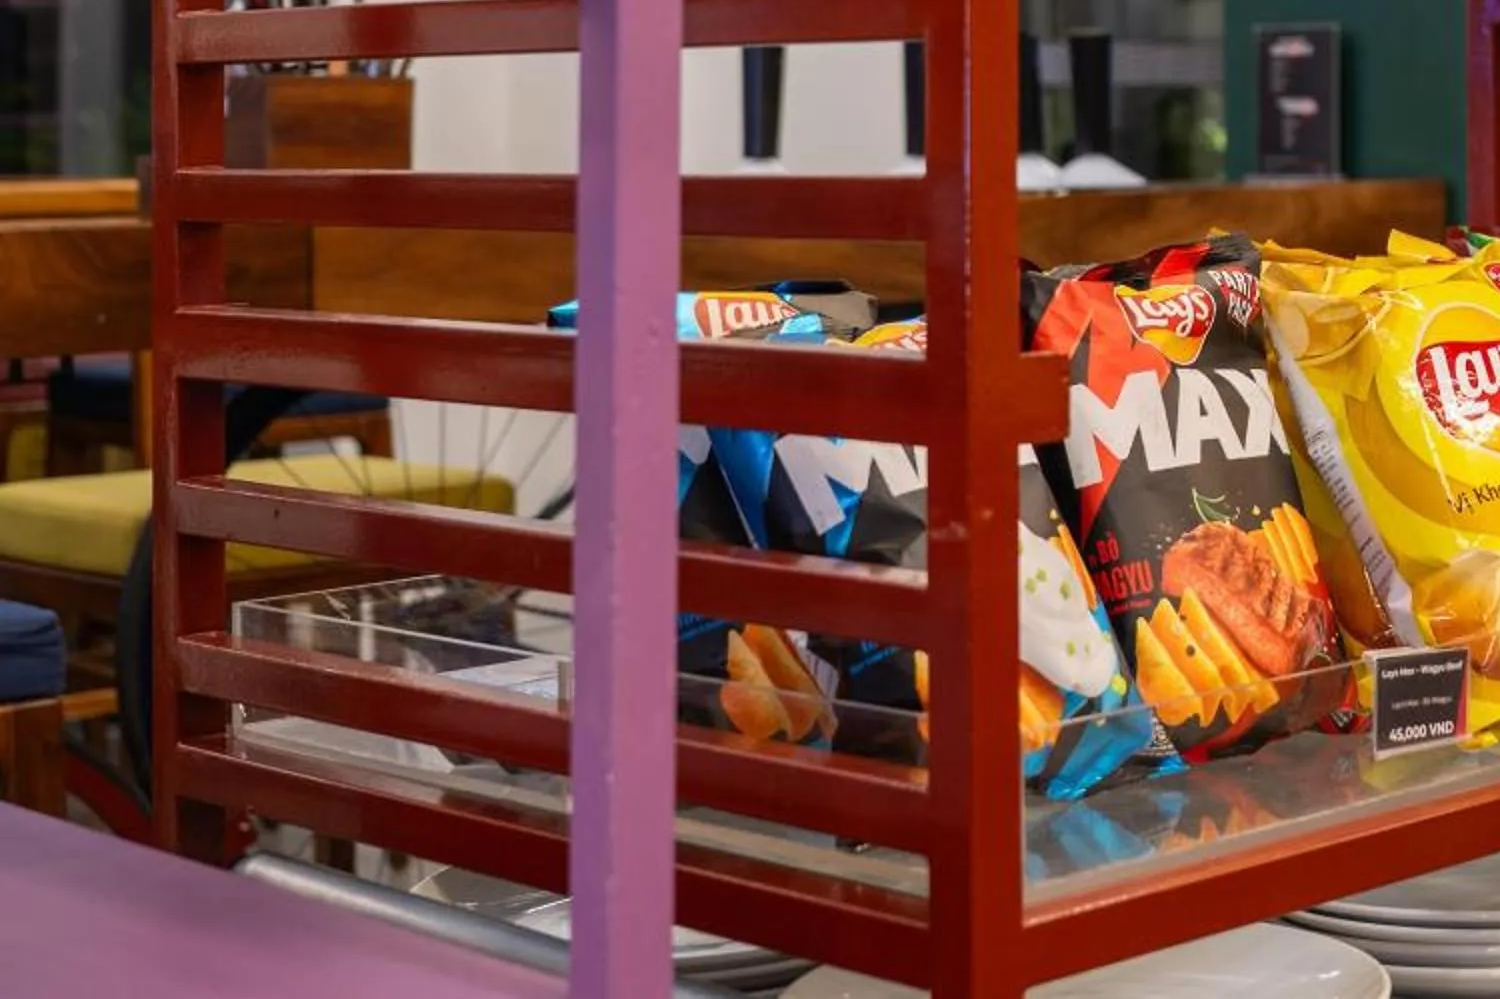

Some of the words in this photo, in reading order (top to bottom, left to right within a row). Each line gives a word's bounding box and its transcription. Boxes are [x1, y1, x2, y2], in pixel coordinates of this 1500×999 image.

[1064, 367, 1291, 490] MAX
[1389, 723, 1428, 742] 45,000
[1429, 720, 1455, 737] VND
